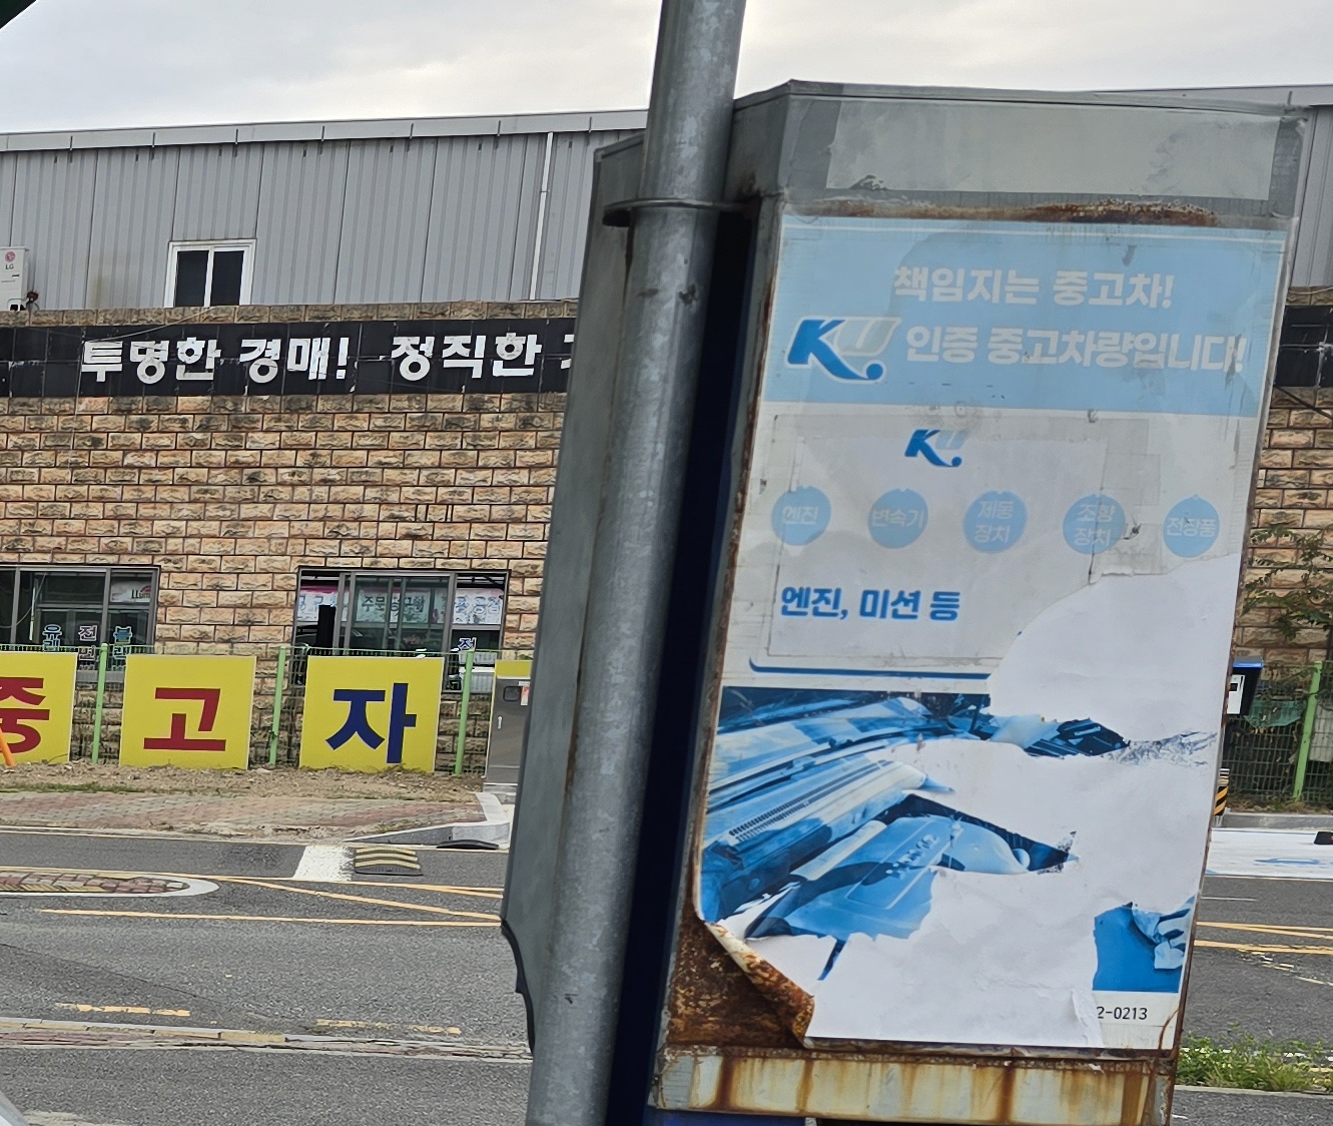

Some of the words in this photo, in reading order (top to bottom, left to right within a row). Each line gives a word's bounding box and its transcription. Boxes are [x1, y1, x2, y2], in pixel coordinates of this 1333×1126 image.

[893, 266, 1039, 305] 책임지는
[1052, 270, 1174, 308] 중고차!
[81, 337, 221, 385] 투명한
[240, 337, 349, 384] 경매!
[390, 332, 542, 381] 정직한
[906, 325, 978, 364] 인증
[987, 326, 1245, 373] 중고차량입니다!
[782, 505, 818, 526] 엔진
[872, 509, 925, 529] 변속기
[1166, 517, 1217, 539] 전장품
[781, 586, 848, 620] 엔진,
[859, 589, 921, 620] 미션
[929, 590, 961, 621] 등
